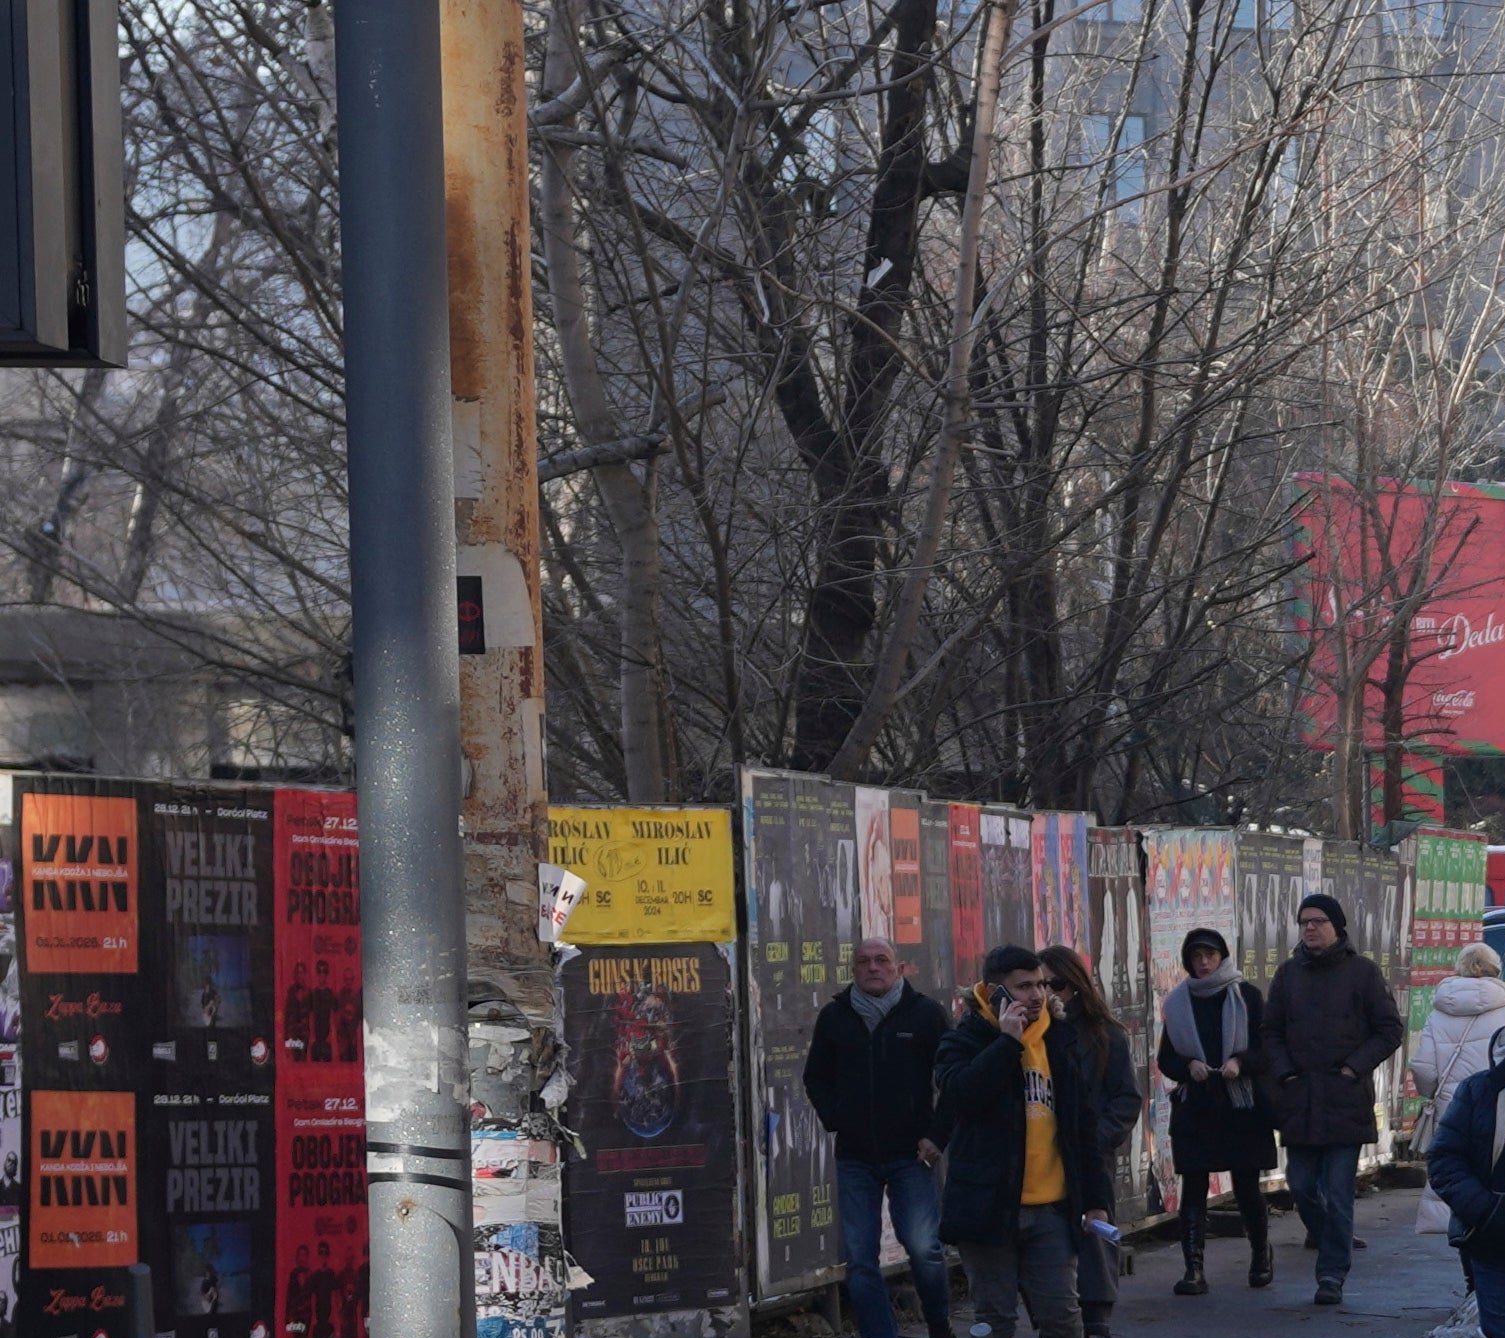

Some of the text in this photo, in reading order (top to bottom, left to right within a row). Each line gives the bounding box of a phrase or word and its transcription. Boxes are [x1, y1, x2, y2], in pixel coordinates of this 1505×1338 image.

[632, 819, 714, 839] MIROSLAV
[165, 830, 256, 877] VELIKI
[657, 841, 691, 866] ILIĆ
[166, 877, 258, 925] PREZIR
[589, 958, 630, 995] GUNS
[651, 957, 700, 993] ROSES
[168, 1119, 259, 1166] VELIKI
[167, 1165, 260, 1213] PREZIR
[625, 1191, 663, 1207] PUBLIC
[626, 1211, 663, 1226] ENEMY
